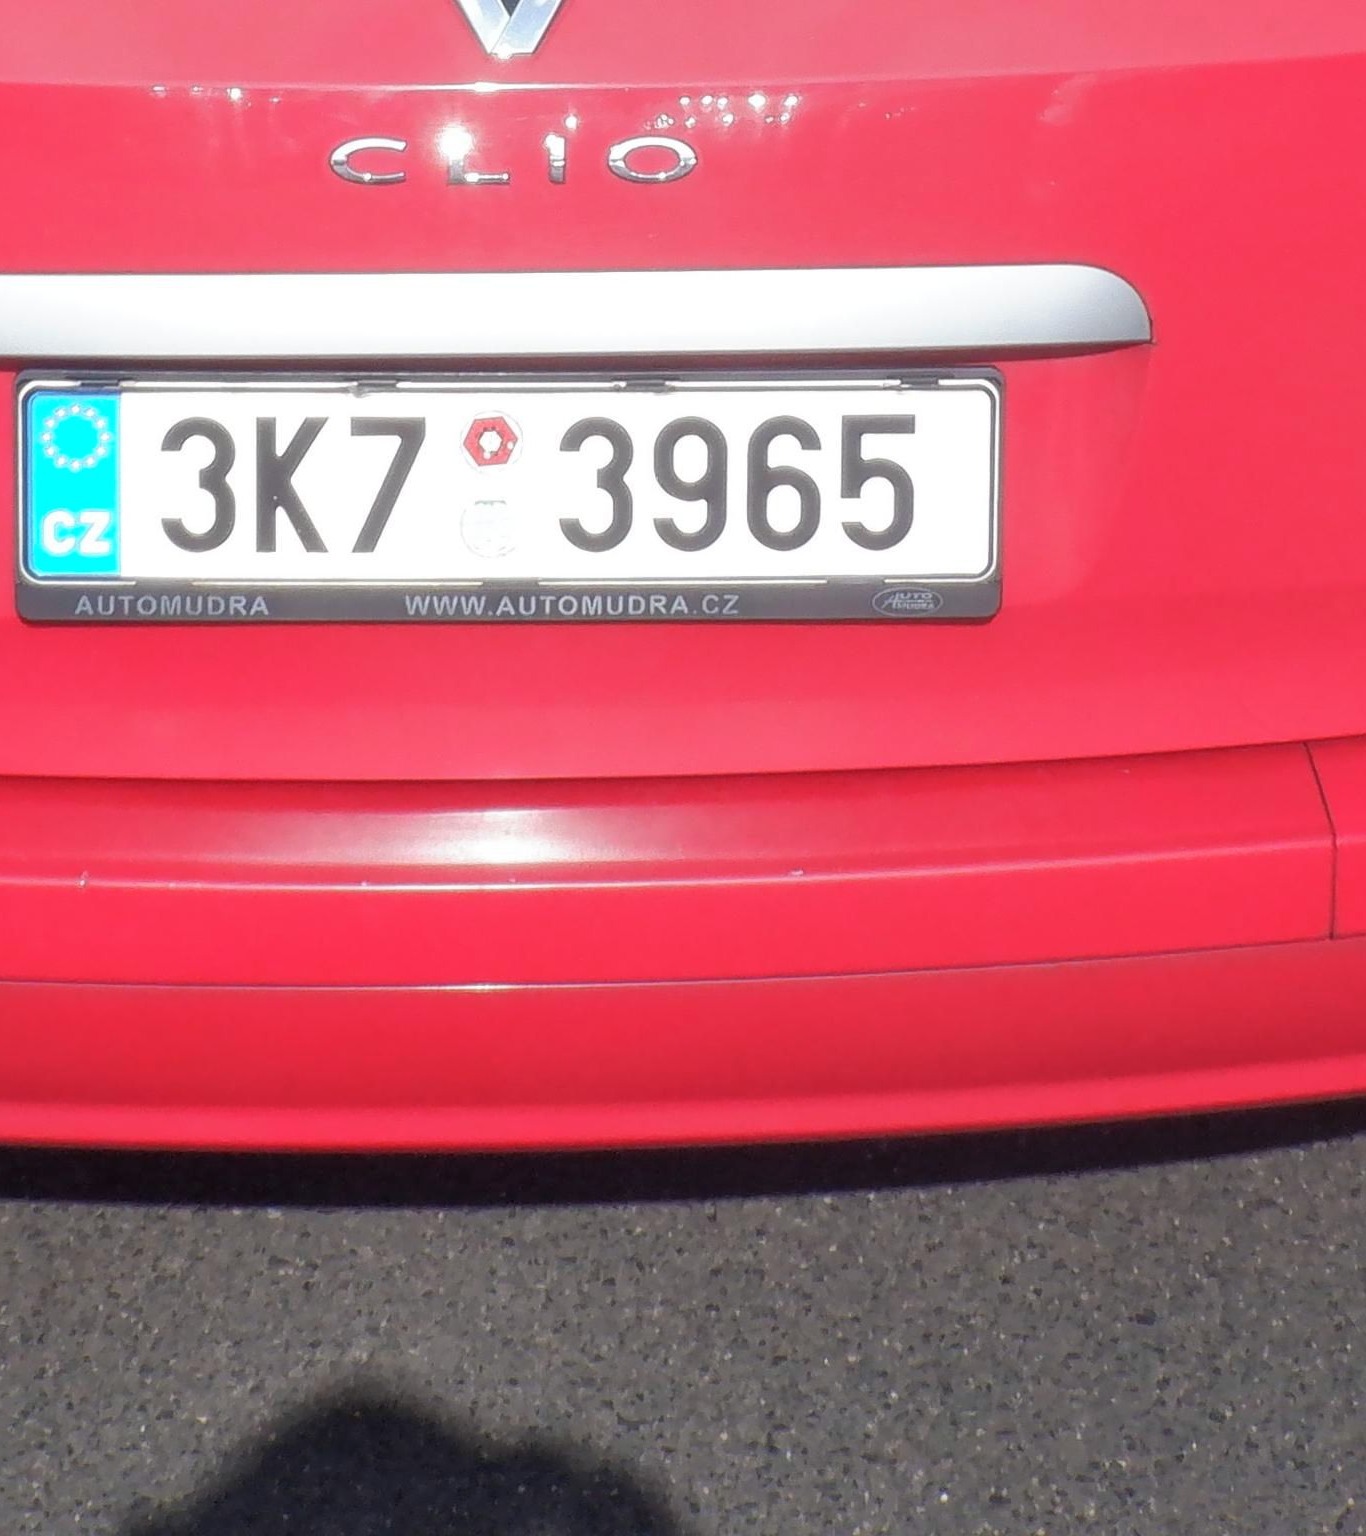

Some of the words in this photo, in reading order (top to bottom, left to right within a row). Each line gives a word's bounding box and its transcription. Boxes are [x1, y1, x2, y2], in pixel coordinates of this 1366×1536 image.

[329, 133, 698, 185] CLIO
[161, 416, 426, 553] 3K7
[559, 414, 916, 553] 3965
[42, 509, 111, 556] CZ
[74, 595, 270, 617] AUTOMUDRA
[404, 595, 740, 617] WWW.AUTOMUDRA.CZ
